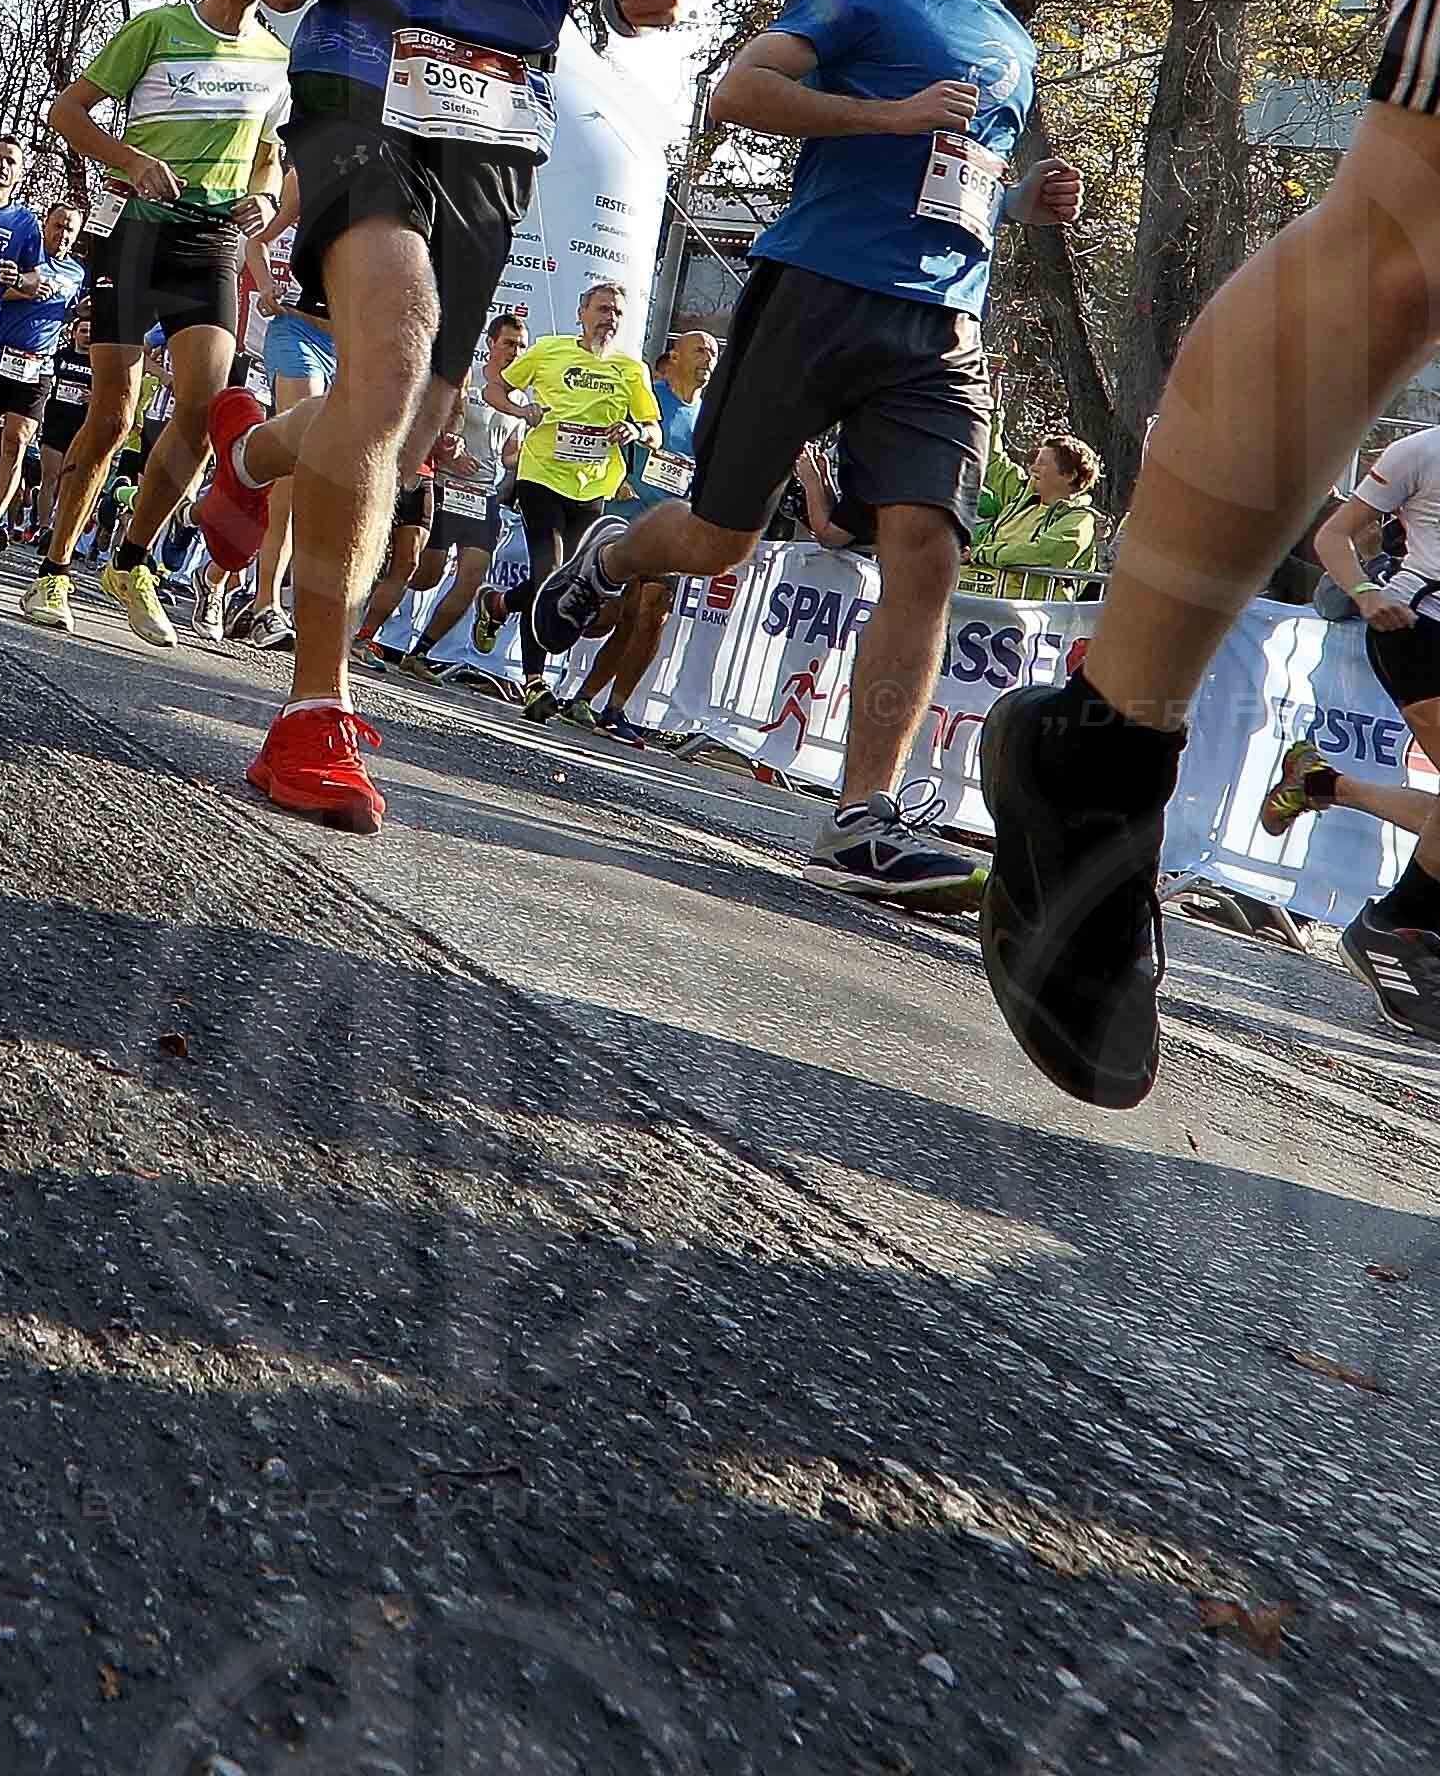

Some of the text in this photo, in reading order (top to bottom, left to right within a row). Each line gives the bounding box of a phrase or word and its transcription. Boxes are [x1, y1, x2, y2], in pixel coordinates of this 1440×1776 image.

[420, 33, 457, 52] GRAZ
[198, 79, 271, 96] KOMPTECH
[423, 62, 489, 99] 5967
[441, 100, 481, 117] Stefan
[595, 195, 628, 215] ERSTE
[572, 379, 600, 393] WORLD
[1271, 695, 1407, 767] ERSTE
